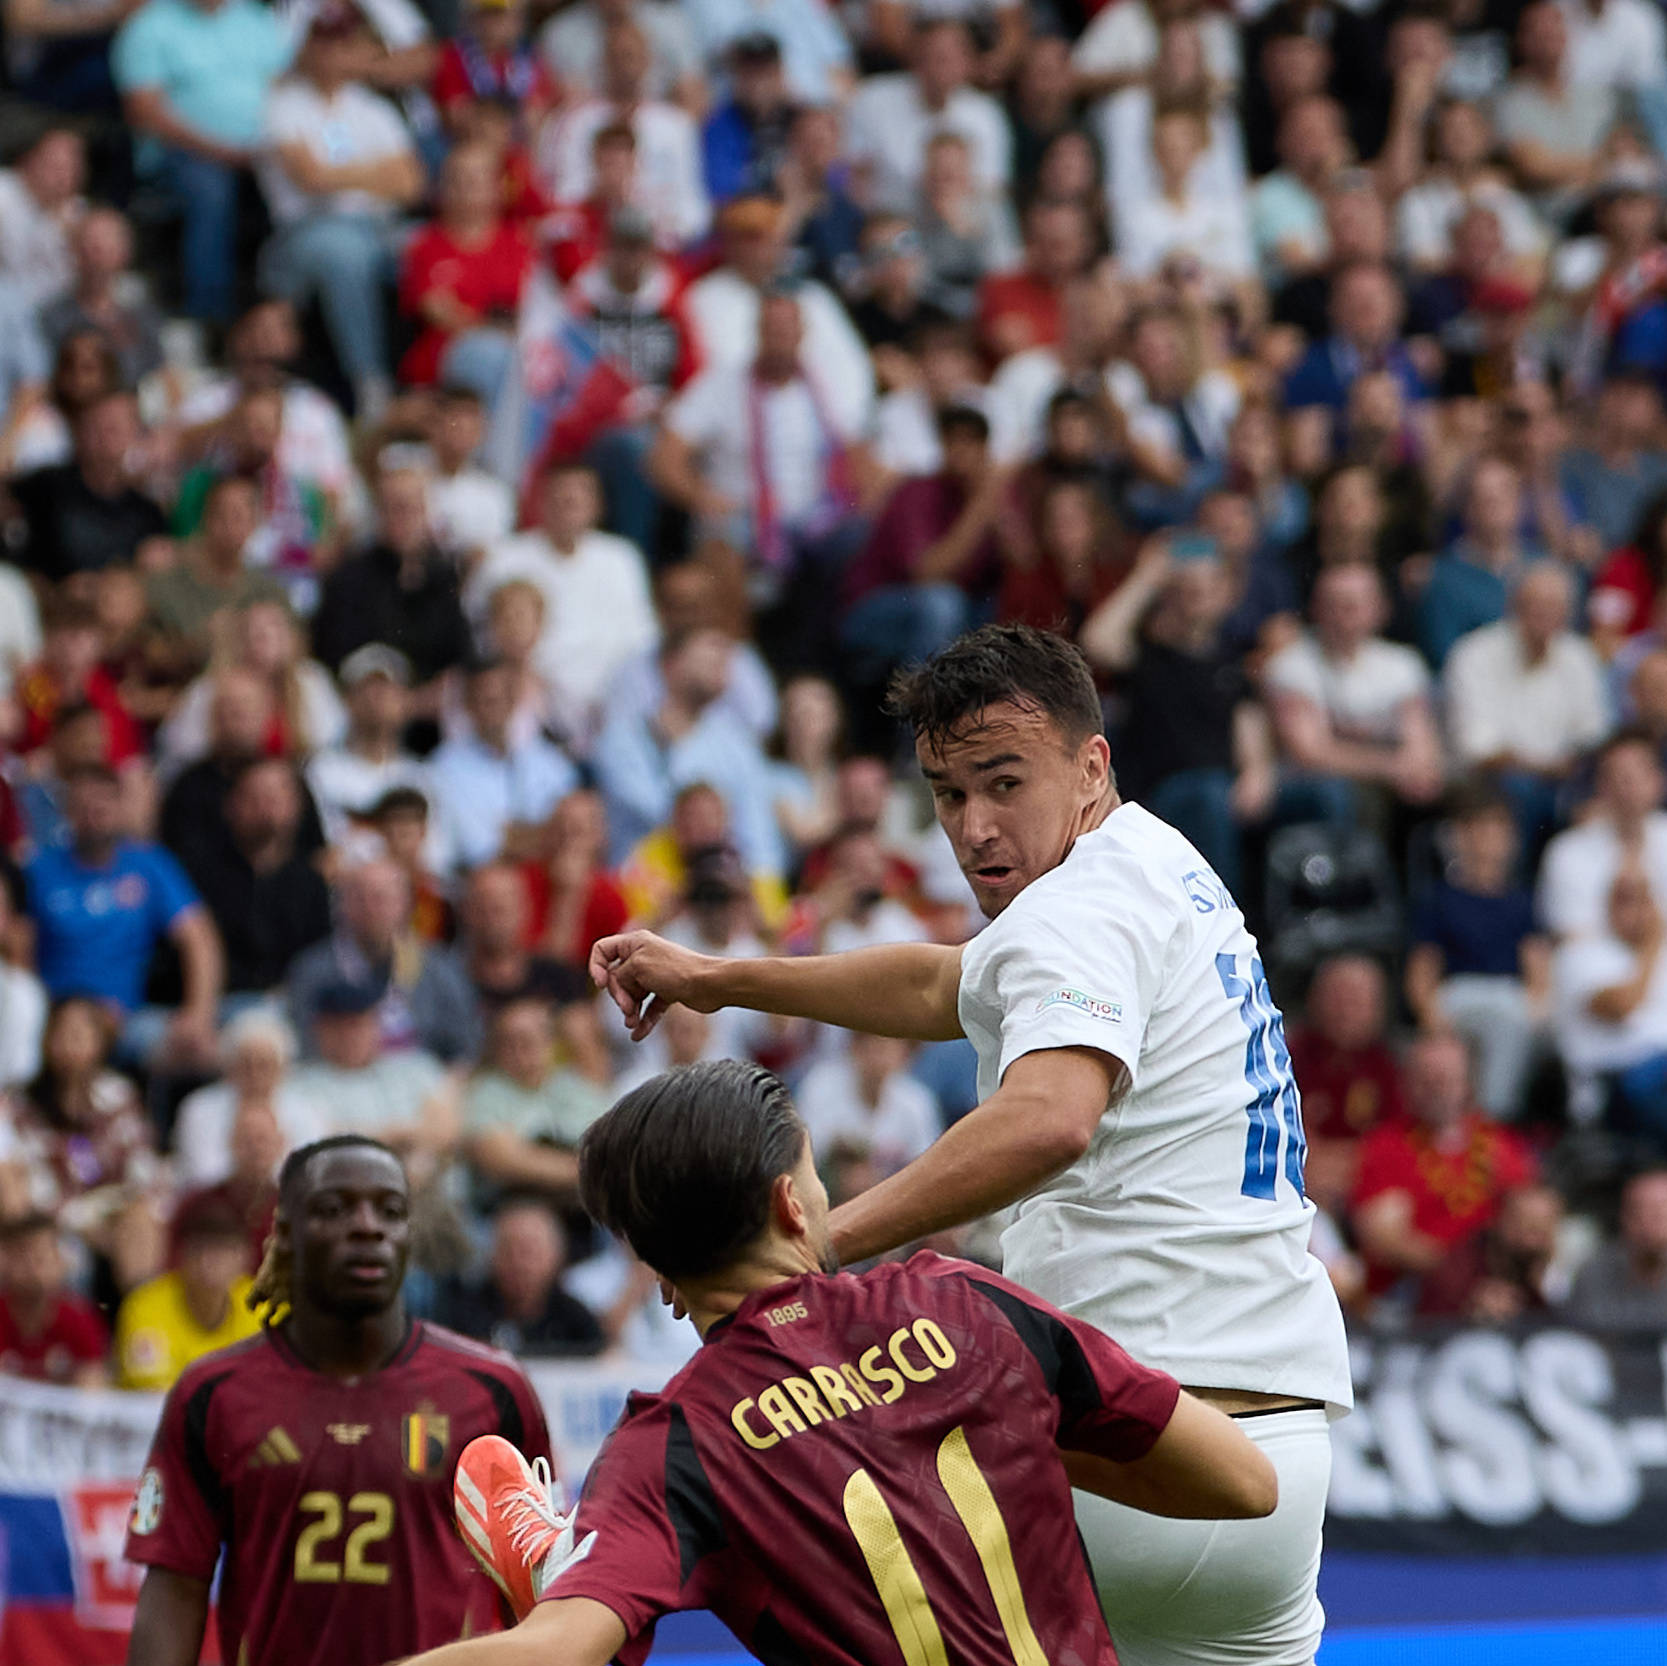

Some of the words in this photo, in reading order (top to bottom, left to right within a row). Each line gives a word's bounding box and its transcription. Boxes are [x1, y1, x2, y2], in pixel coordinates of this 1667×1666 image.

[1036, 989, 1123, 1017] UNDATION
[763, 1301, 809, 1327] 1895
[731, 1317, 958, 1451] CARRASCO
[293, 1490, 395, 1585] 22
